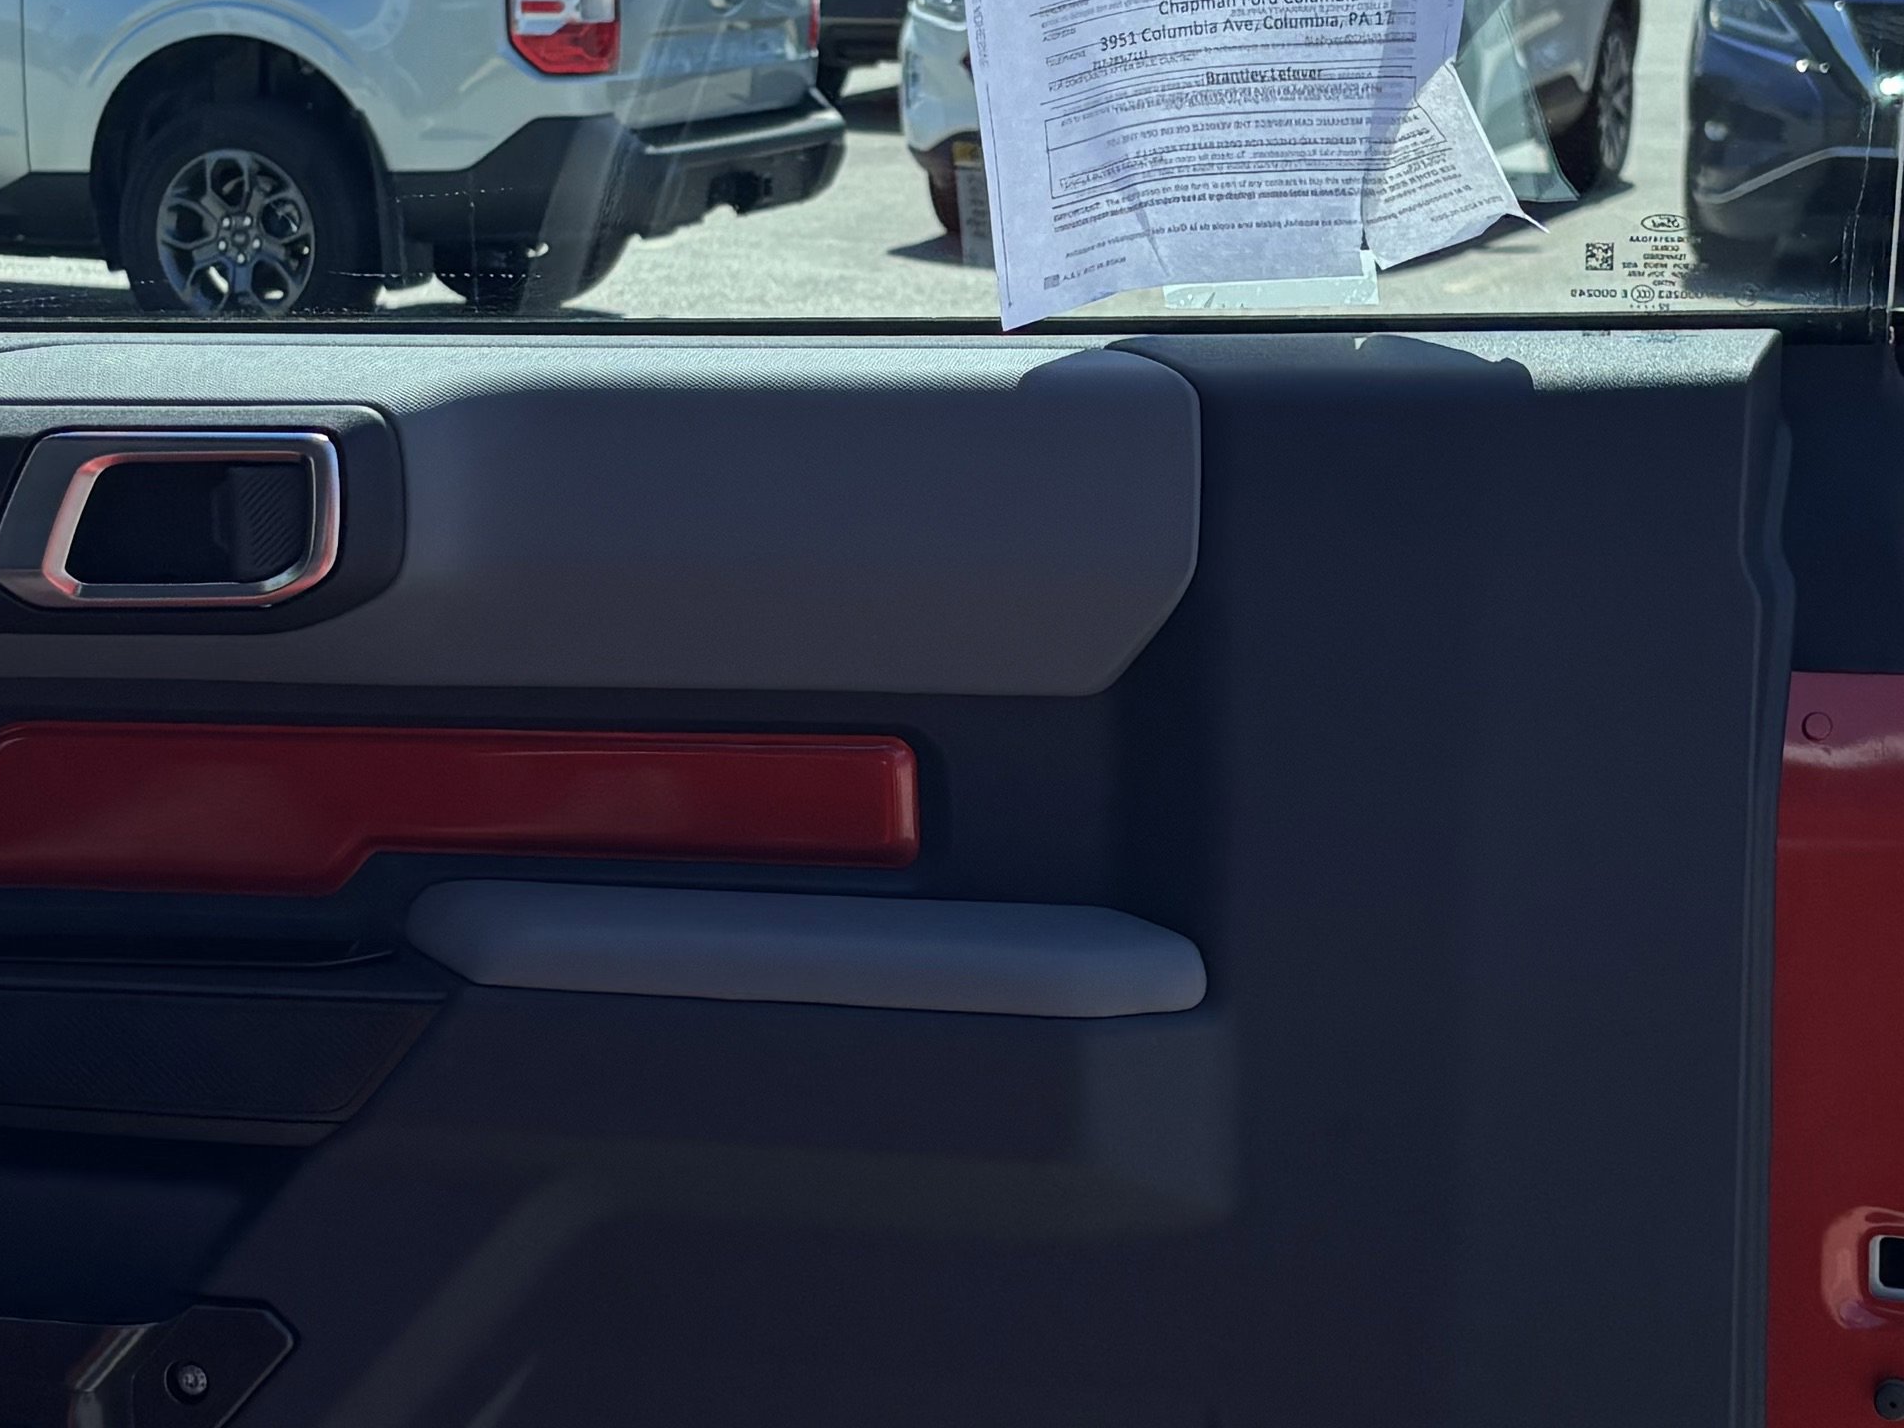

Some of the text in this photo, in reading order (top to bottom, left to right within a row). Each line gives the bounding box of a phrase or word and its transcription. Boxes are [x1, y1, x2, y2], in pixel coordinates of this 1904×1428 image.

[1099, 31, 1137, 52] 3951
[1141, 20, 1218, 43] Columbia
[1262, 13, 1344, 32] Columbia,
[1347, 12, 1369, 27] PA
